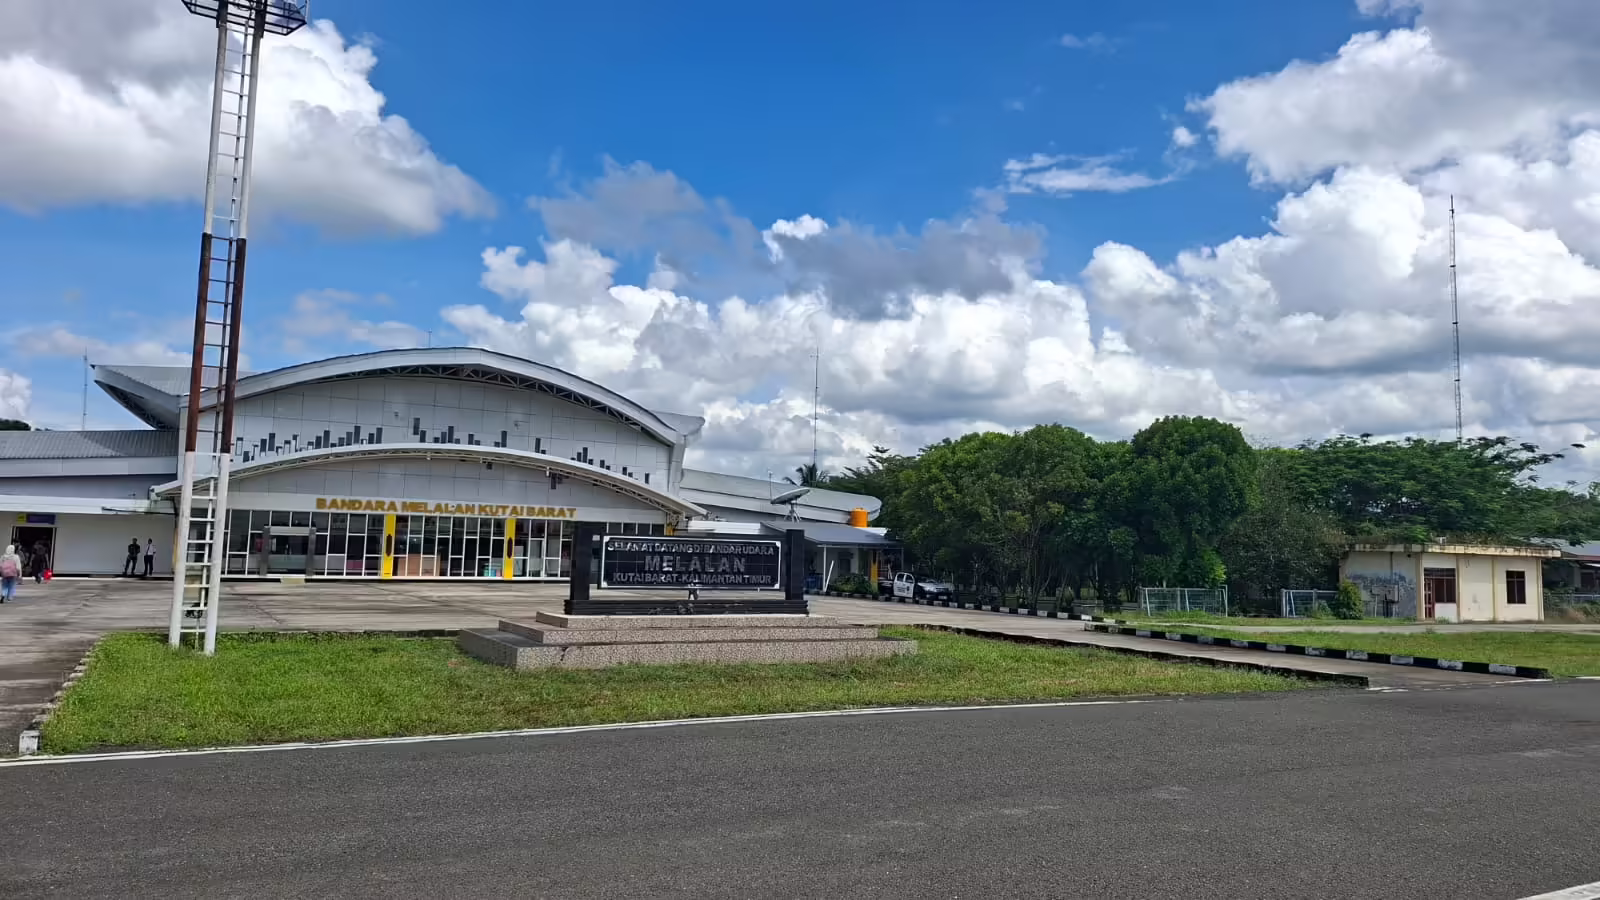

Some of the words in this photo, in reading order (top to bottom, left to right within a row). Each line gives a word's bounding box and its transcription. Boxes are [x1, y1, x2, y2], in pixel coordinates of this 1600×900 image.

[316, 498, 398, 512] BANDARA
[401, 501, 475, 514] MELALAN
[479, 504, 524, 516] KUTAI
[526, 506, 576, 518] BARAT
[655, 543, 693, 553] DATANG
[743, 546, 774, 555] UDARA
[644, 555, 746, 572] MELALAN
[613, 572, 644, 582] KUTAI
[743, 575, 771, 584] TIMUR
